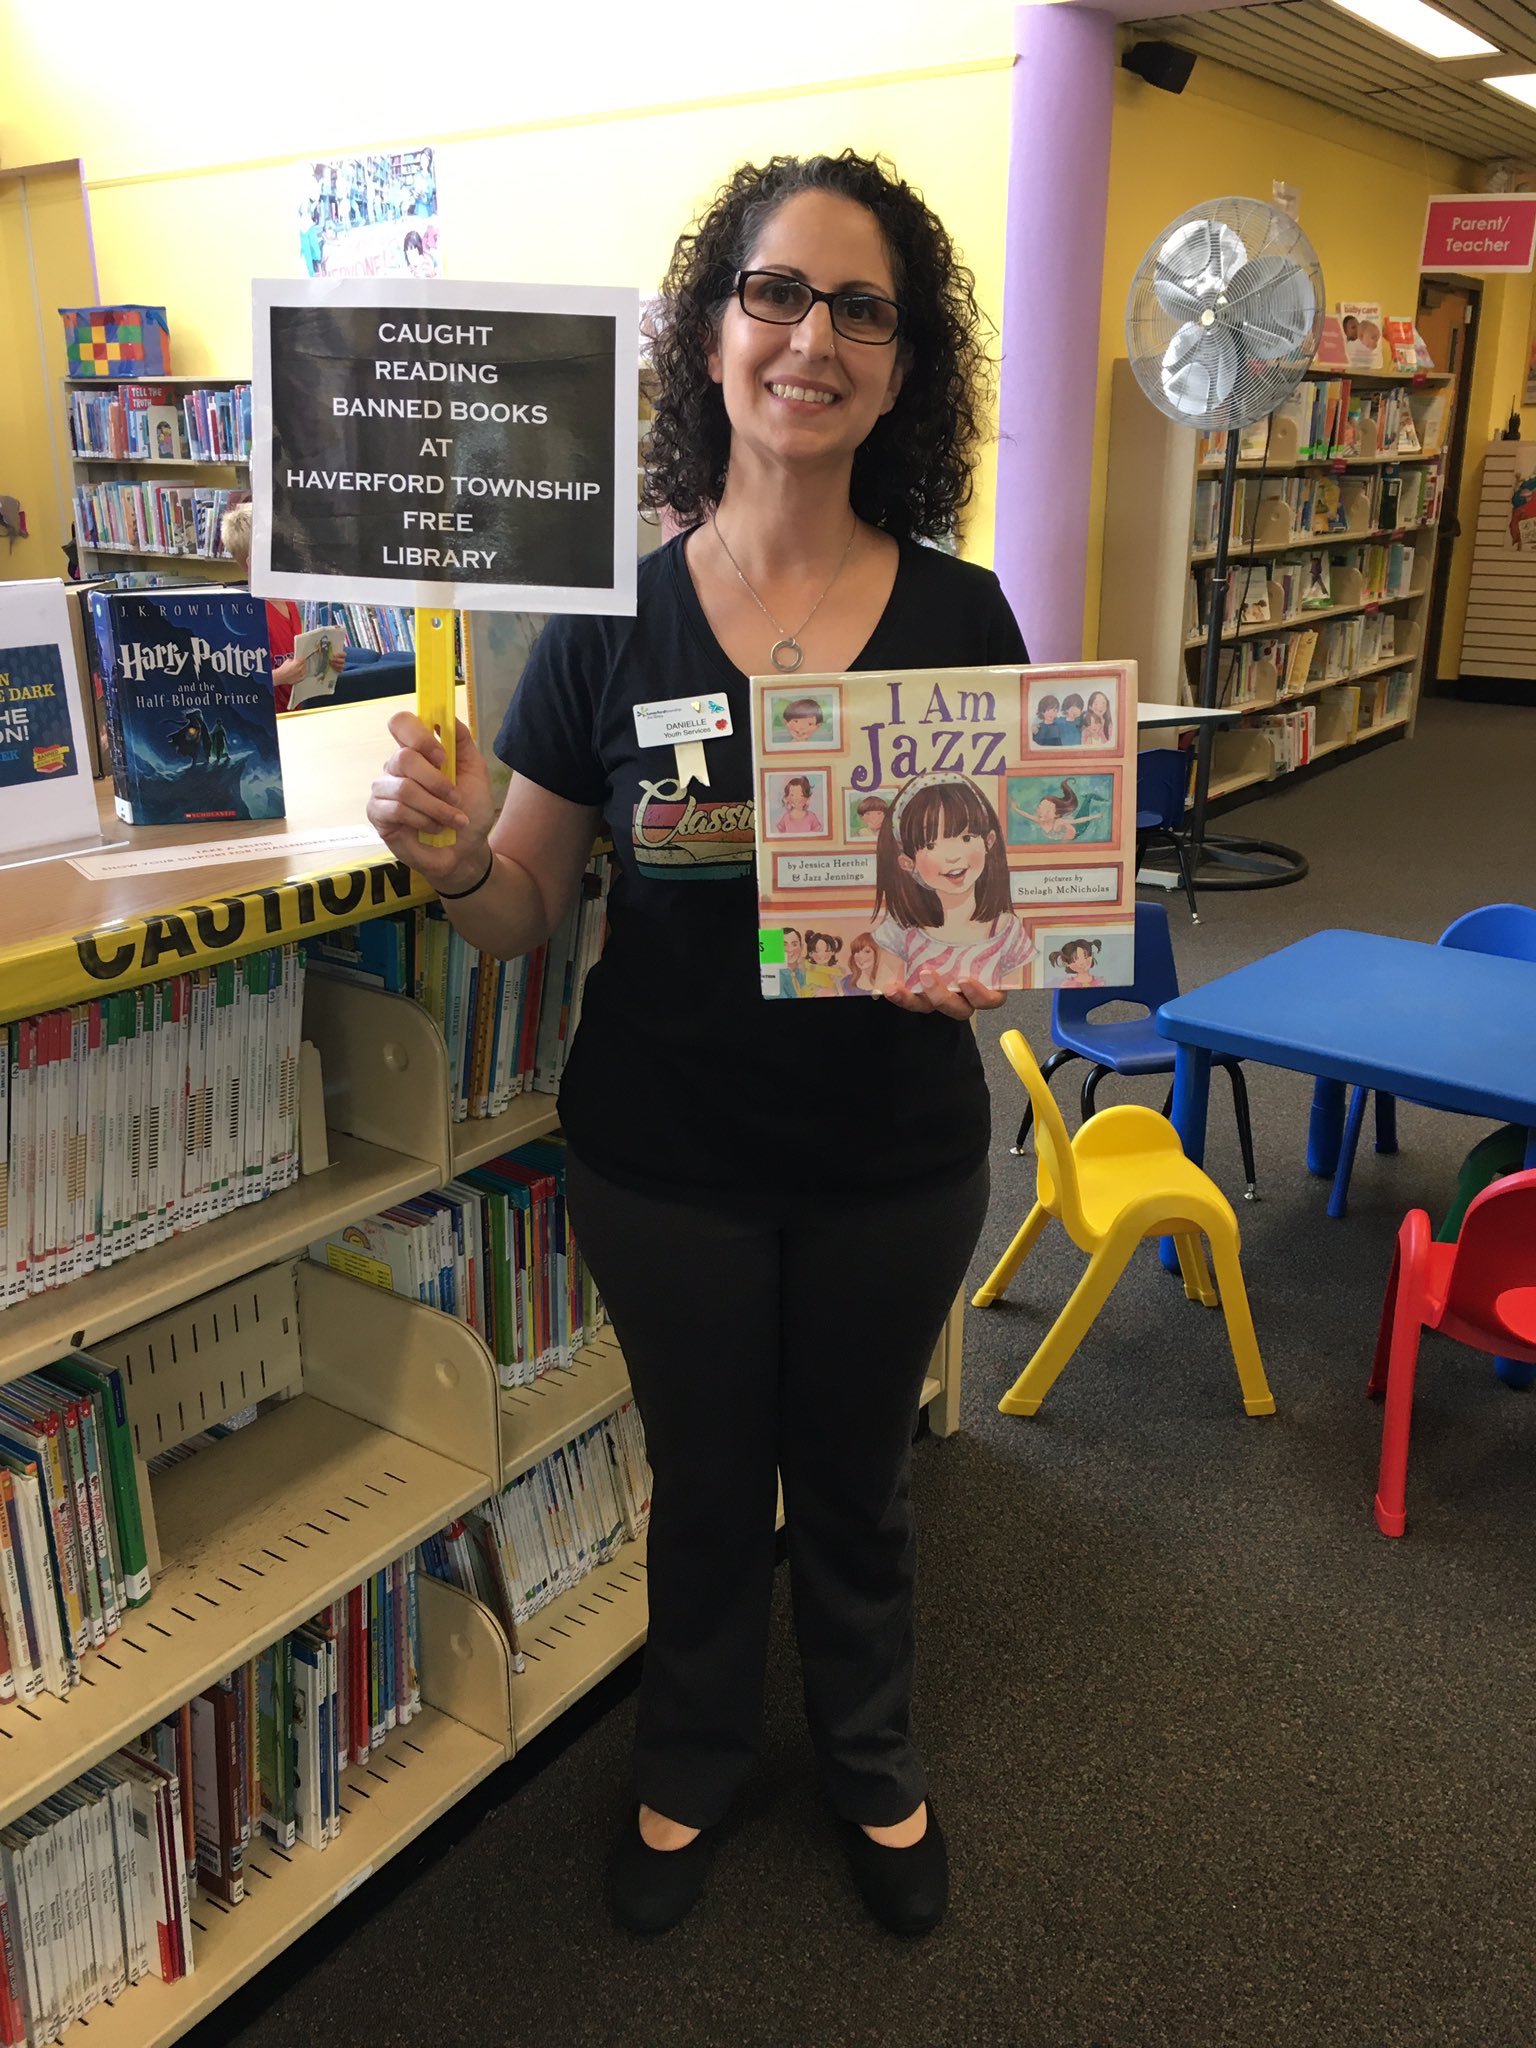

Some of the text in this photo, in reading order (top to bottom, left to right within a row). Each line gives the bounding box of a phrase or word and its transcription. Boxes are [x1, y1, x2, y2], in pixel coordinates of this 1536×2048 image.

[1452, 215, 1511, 232] Parent/
[1446, 238, 1510, 252] Teacher
[1344, 305, 1378, 314] baby care
[378, 323, 493, 347] CAUGHT
[374, 360, 498, 384] READING
[131, 388, 163, 397] TELL THE
[332, 397, 548, 425] BANNED BOOKS
[419, 437, 453, 458] AT
[286, 469, 601, 502] HAVERFORD TOWNSHIP
[403, 510, 474, 533] FREE
[382, 546, 497, 570] LIBRARY
[121, 603, 254, 618] J. K. ROWLING
[117, 636, 268, 681] Harry Potter
[9, 683, 57, 702] DARK
[177, 682, 215, 693] and the
[136, 692, 259, 708] Half-Blood Prince
[887, 683, 997, 725] I Am
[0, 707, 30, 725] HE
[666, 718, 707, 731] DANIELLE
[664, 727, 711, 739] Youth Services
[851, 722, 1008, 793] Jazz
[192, 811, 236, 819] SCHOLASTIC
[635, 778, 755, 848] Classi
[101, 863, 138, 873] SHOW
[142, 858, 175, 867] YOUR
[177, 851, 228, 863] SUPPORT
[787, 857, 869, 871] by Jessica Herthel
[803, 872, 823, 883] Jazz
[825, 870, 865, 884] Jennings
[1044, 874, 1084, 886] pictures by
[1018, 883, 1111, 899] Shelagh McNicholas
[72, 858, 412, 981] CAUTION
[503, 980, 512, 1010] JULIUS
[452, 995, 461, 1036] CHESTER
[93, 1491, 102, 1520] YASMIN
[78, 1499, 93, 1566] YASMIN The Teacher
[61, 1518, 69, 1545] YASMIN
[66, 1564, 75, 1591] Superhero
[97, 1536, 105, 1552] Chef
[8, 1967, 18, 2001] RECORDS
